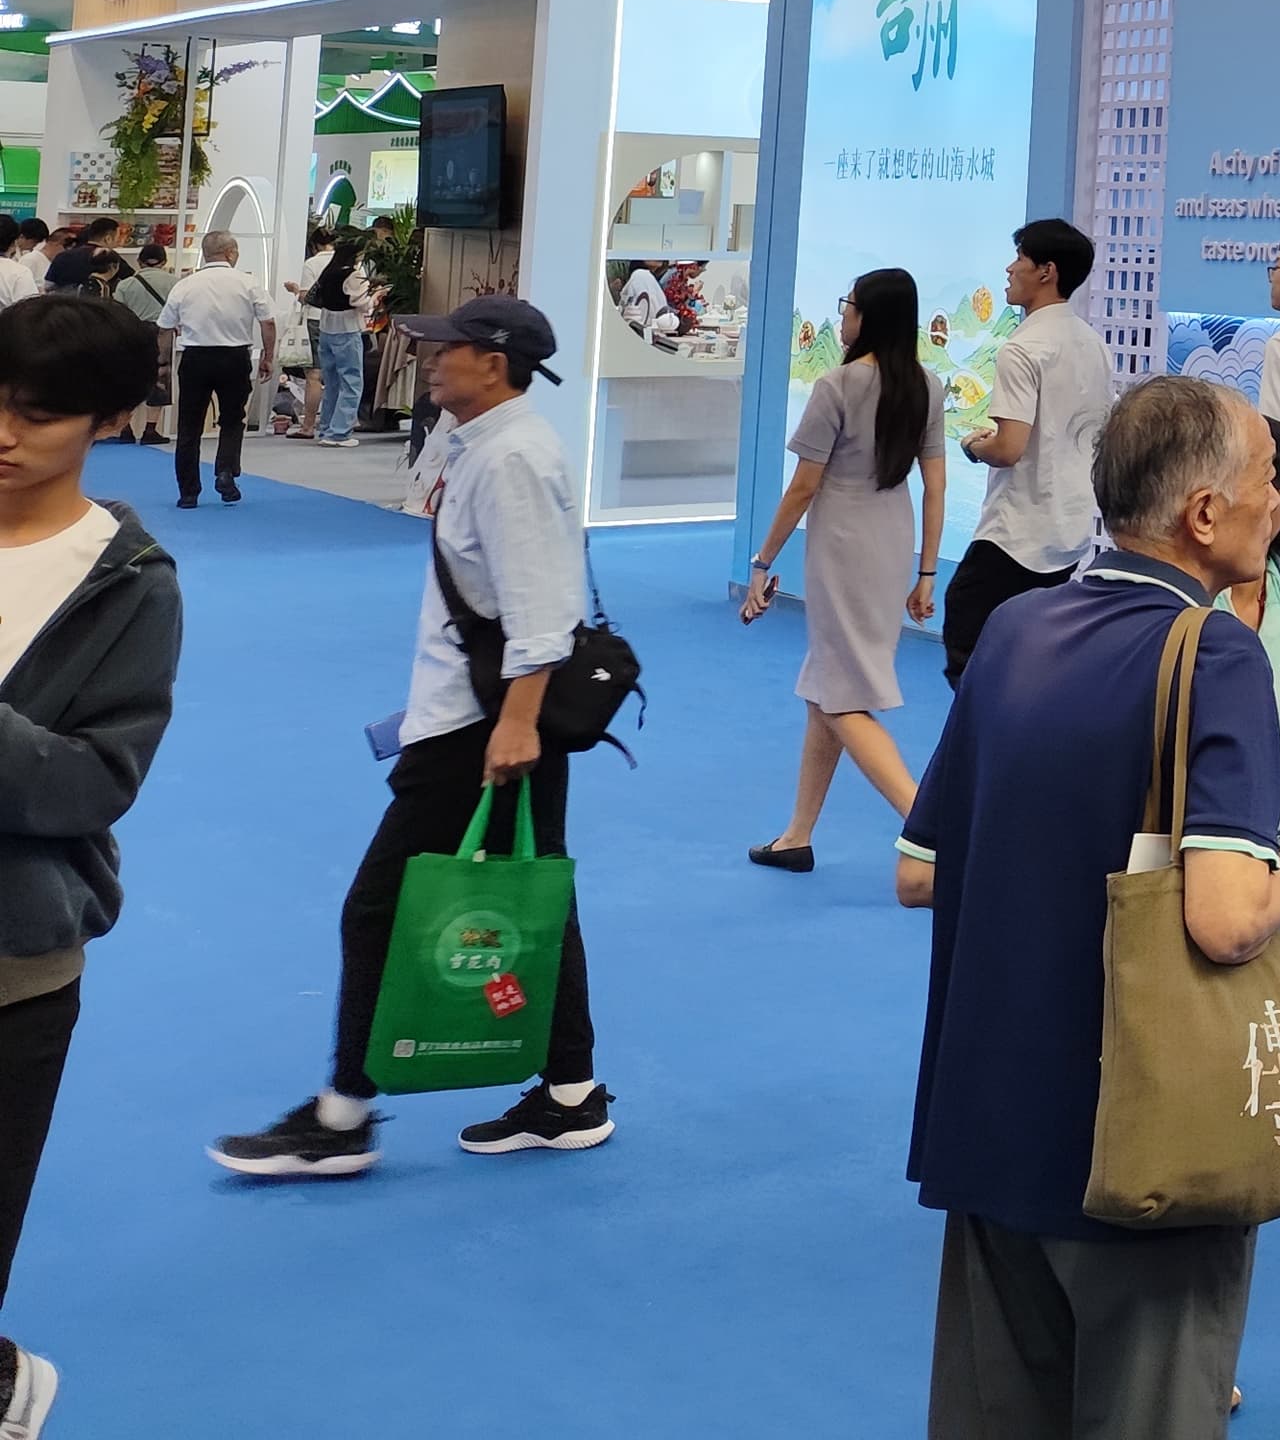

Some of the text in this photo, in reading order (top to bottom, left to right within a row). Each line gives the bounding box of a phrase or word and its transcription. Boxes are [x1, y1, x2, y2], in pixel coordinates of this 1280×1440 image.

[823, 147, 996, 182] 一座来了就想吃的山海水城
[1174, 193, 1208, 218] and
[1208, 198, 1248, 219] seas
[1201, 236, 1244, 261] taste
[1246, 240, 1280, 262] onc
